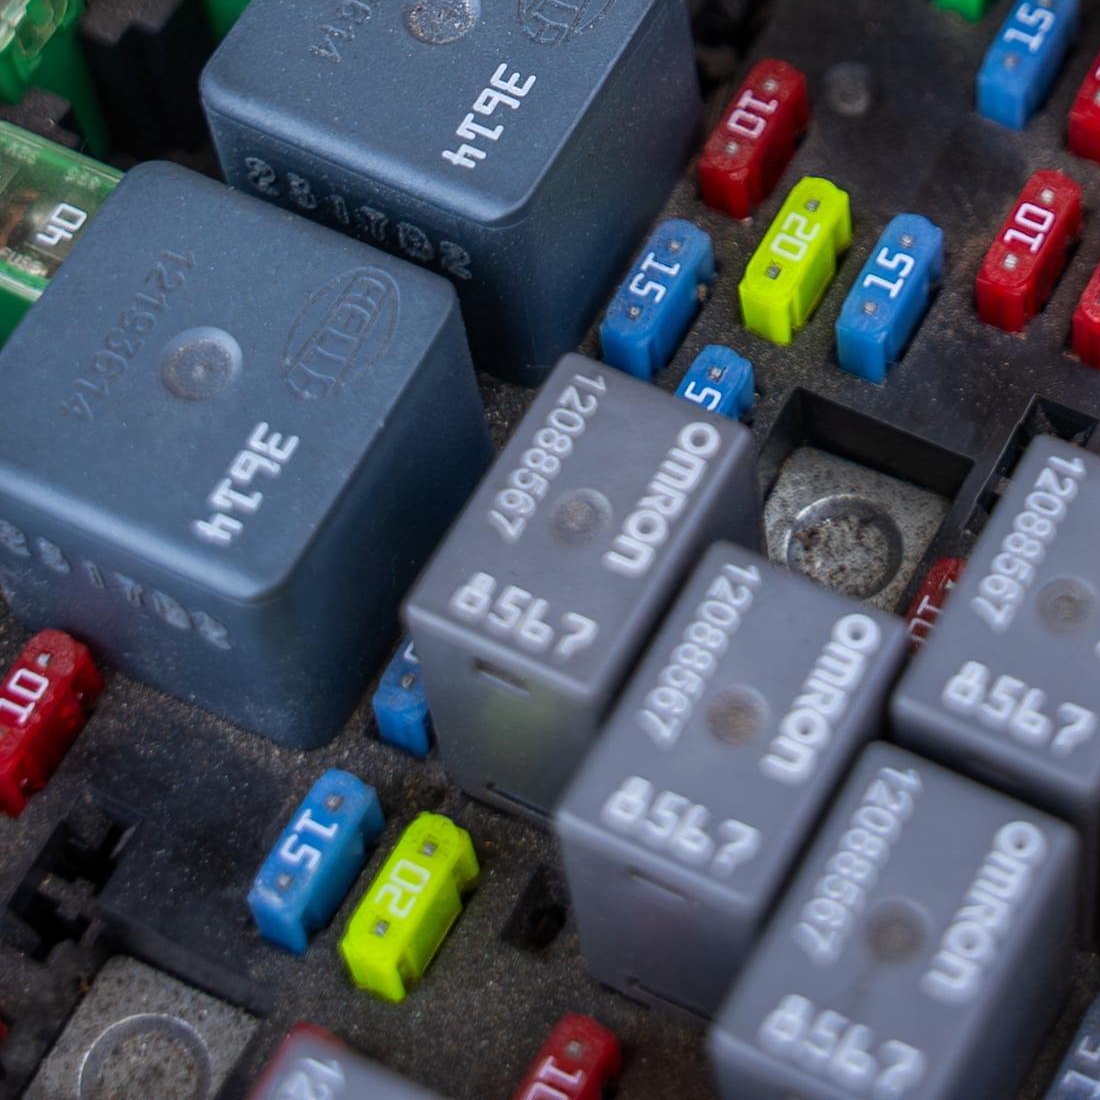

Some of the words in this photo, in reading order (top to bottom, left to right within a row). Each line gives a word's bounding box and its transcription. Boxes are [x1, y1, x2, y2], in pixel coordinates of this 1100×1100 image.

[1004, 2, 1056, 52] 15
[442, 63, 536, 170] 3614
[727, 89, 779, 140] 10
[36, 202, 88, 246] 40
[770, 212, 822, 263] 20
[1003, 201, 1056, 254] 10
[629, 251, 681, 303] 15
[863, 246, 915, 299] 15
[59, 251, 197, 421] 12193614
[684, 381, 722, 412] 5
[191, 422, 300, 546] 3614
[486, 373, 607, 544] 12088567
[970, 454, 1087, 633] 12088567
[450, 571, 598, 661] 8567
[634, 562, 762, 749] 12088567
[0, 667, 50, 725] 10
[942, 660, 1097, 758] 8567
[281, 808, 339, 872] 15
[600, 775, 761, 878] 8567
[375, 859, 431, 920] 20
[791, 766, 923, 968] 12088567
[759, 993, 925, 1098] 8567
